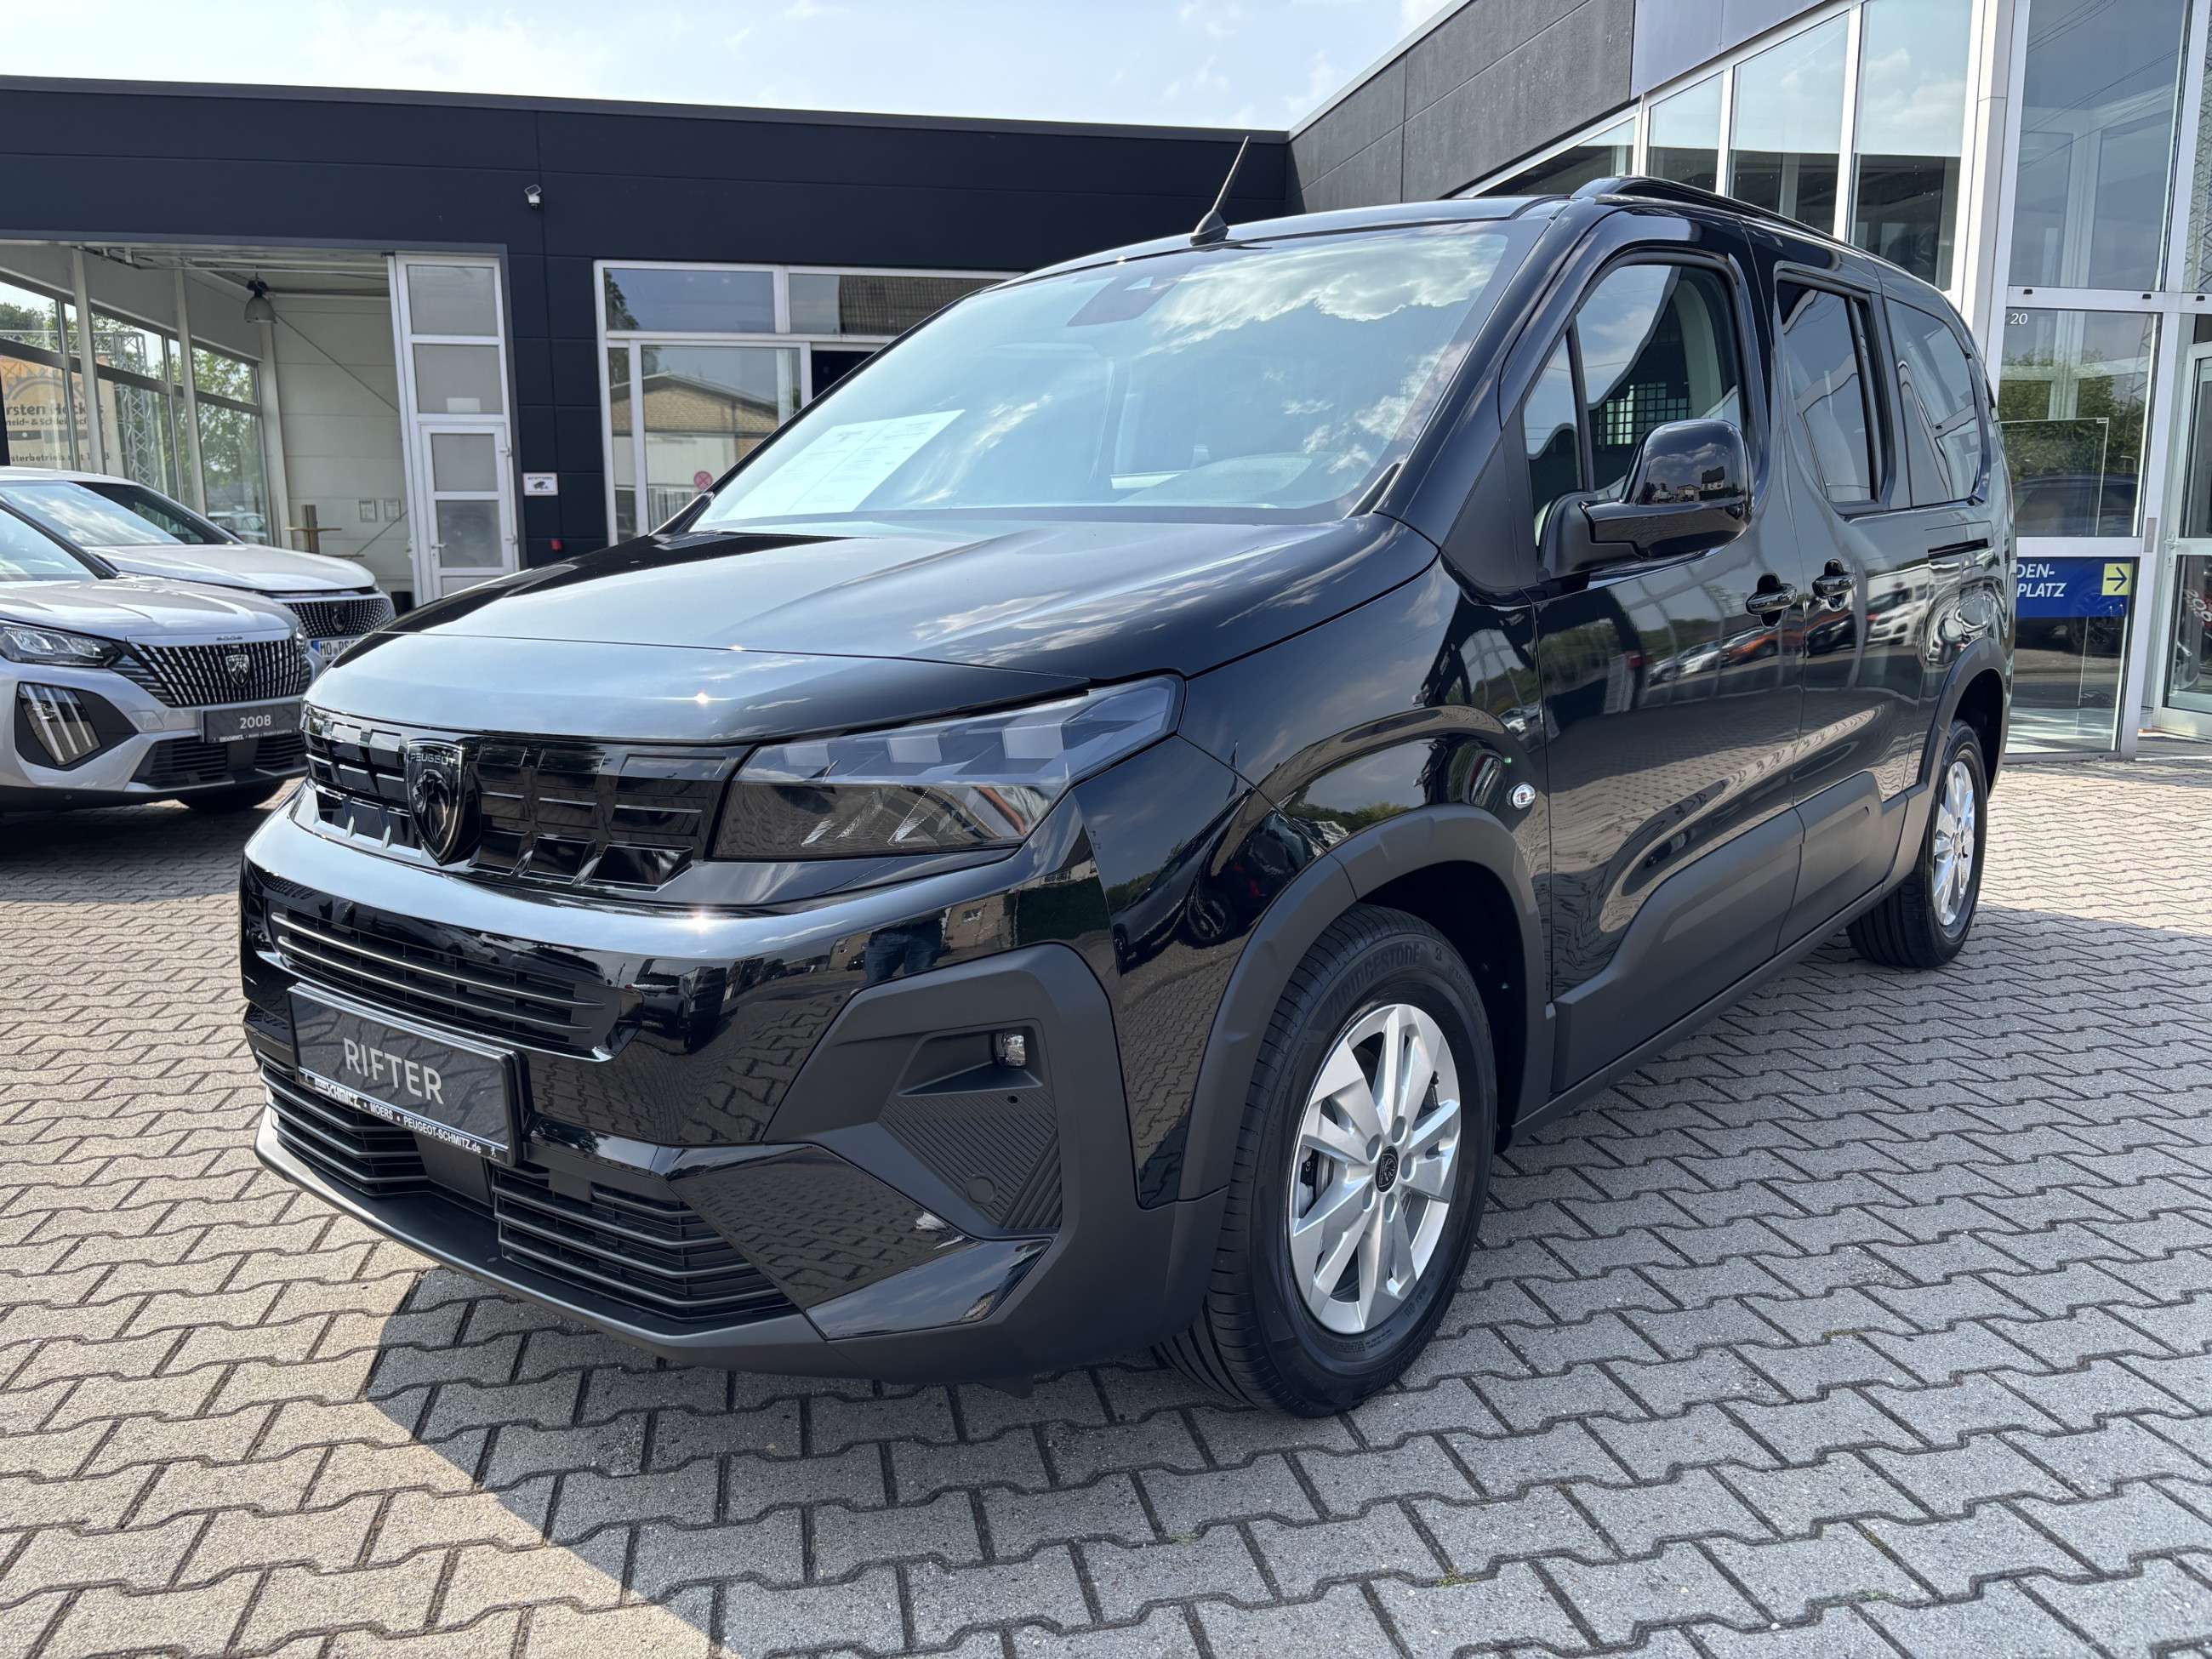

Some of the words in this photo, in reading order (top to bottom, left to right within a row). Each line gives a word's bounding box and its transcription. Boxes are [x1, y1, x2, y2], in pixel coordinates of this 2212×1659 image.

[2010, 312, 2028, 325] 20
[2016, 563, 2055, 579] DEN-
[2016, 582, 2067, 598] PLATZ
[320, 641, 333, 656] MO
[239, 715, 271, 729] 2008
[409, 751, 457, 767] PEUGEOT
[343, 1037, 444, 1105] RIFTER
[369, 1101, 394, 1121] MOERS
[403, 1115, 482, 1154] PEUGEOT-SCHMITZ.de
